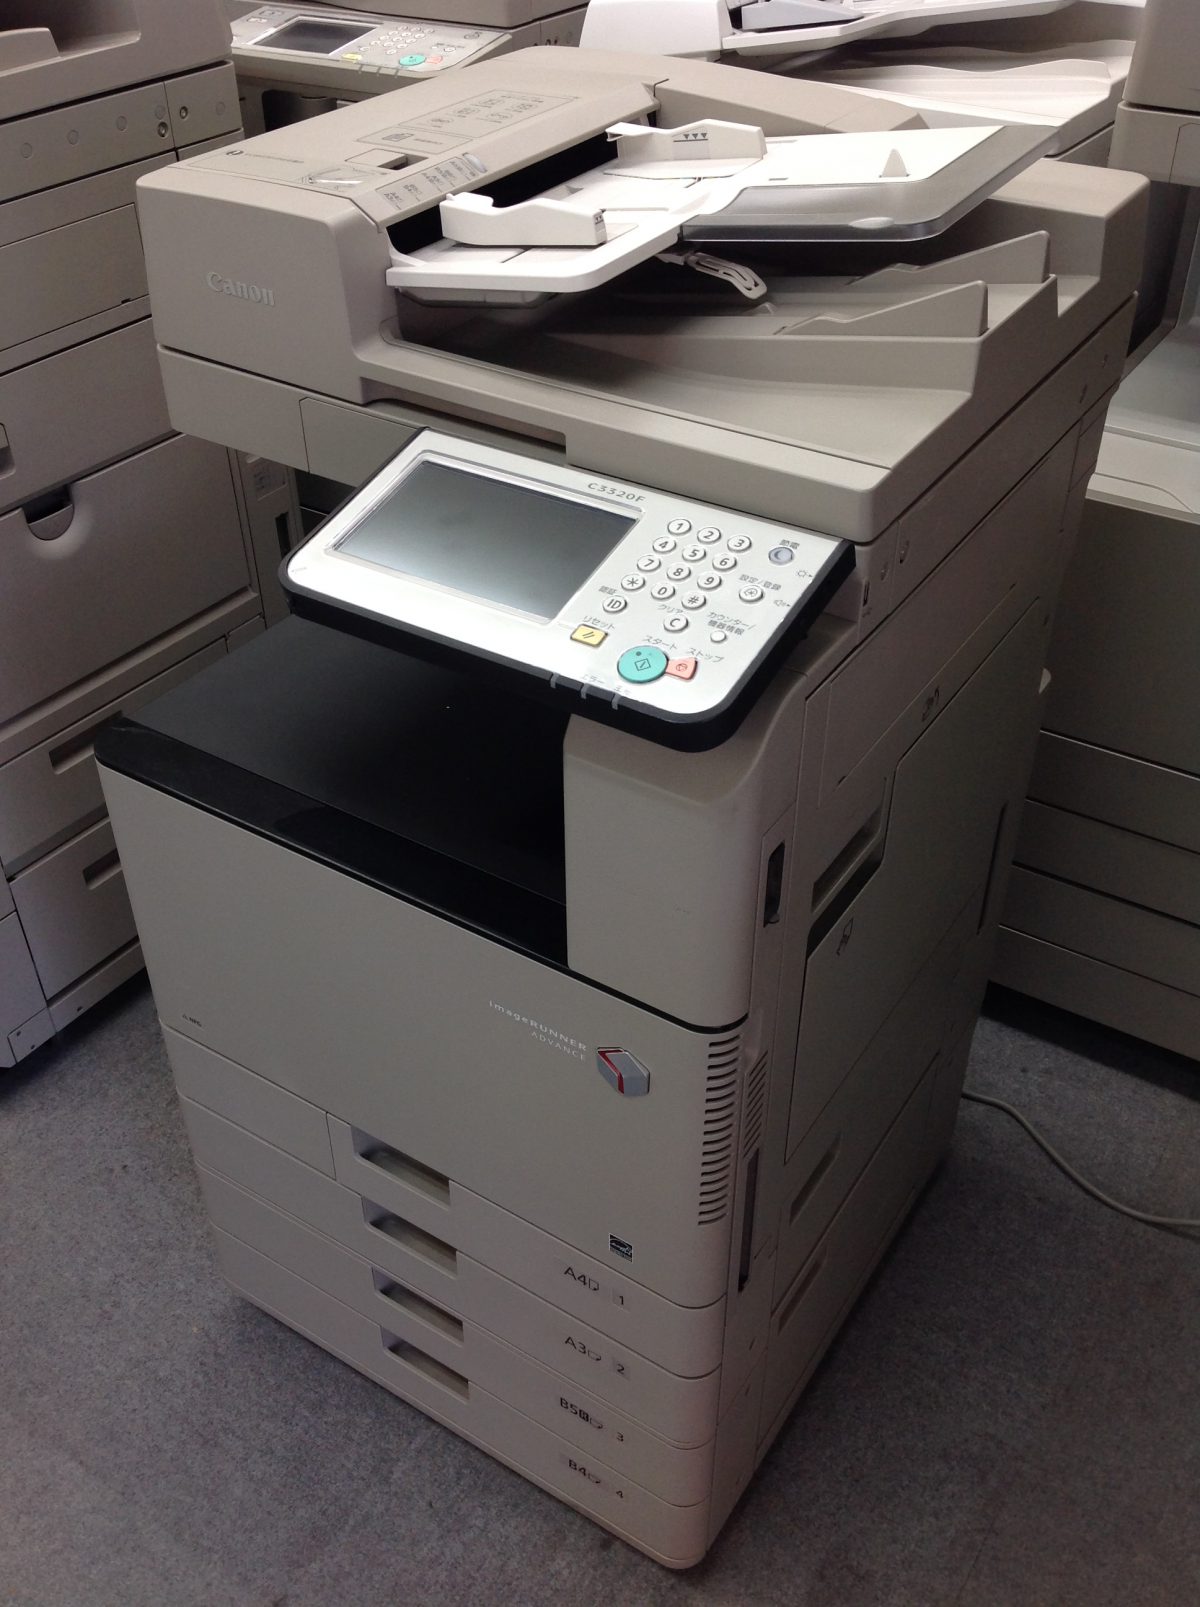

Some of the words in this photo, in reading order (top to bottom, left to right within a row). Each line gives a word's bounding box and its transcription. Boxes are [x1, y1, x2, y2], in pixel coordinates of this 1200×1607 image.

[206, 271, 275, 306] Canon
[587, 482, 646, 502] C3320F
[703, 530, 714, 540] 2
[658, 540, 668, 549] 4
[734, 538, 745, 548] 3
[688, 549, 698, 558] 5
[644, 558, 654, 568] 7
[719, 557, 730, 566] 6
[673, 567, 683, 576] 8
[705, 575, 714, 585] 9
[606, 598, 621, 609] ID
[670, 618, 681, 628] C
[642, 634, 677, 650] スタート
[568, 1458, 588, 1477] B4
